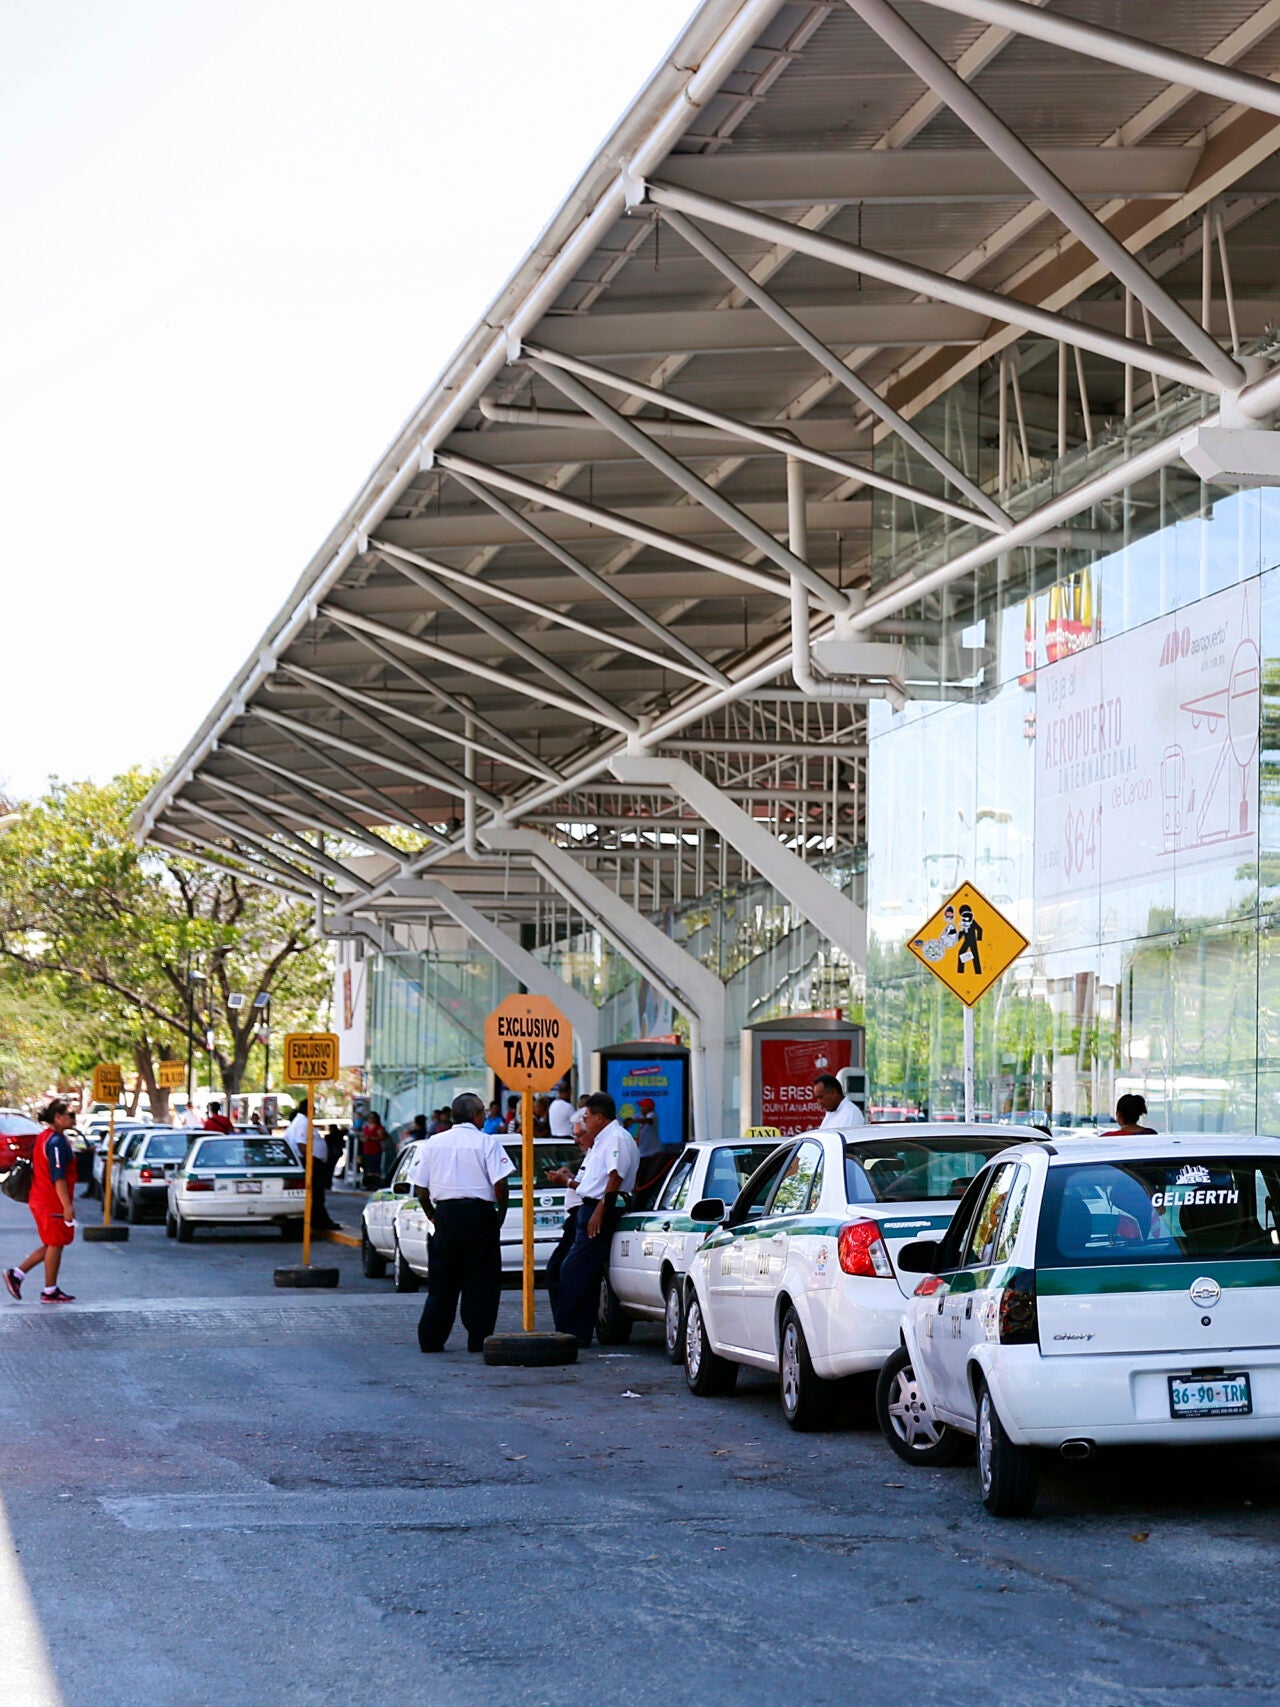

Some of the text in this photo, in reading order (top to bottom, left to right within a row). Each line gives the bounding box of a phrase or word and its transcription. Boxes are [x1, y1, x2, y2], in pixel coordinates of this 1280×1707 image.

[1158, 626, 1191, 668] ADO
[1045, 696, 1122, 770] AEROPUERTO
[1058, 743, 1138, 794] INTERNACIONAL
[498, 1016, 560, 1038] EXCLUSIVO
[292, 1043, 331, 1059] EXCLUSIVO
[503, 1041, 555, 1069] TAXIS
[296, 1060, 328, 1076] TAXIS
[780, 1086, 814, 1101] ERES
[749, 1129, 776, 1138] TAXI
[1151, 1190, 1239, 1208] GELBERTH
